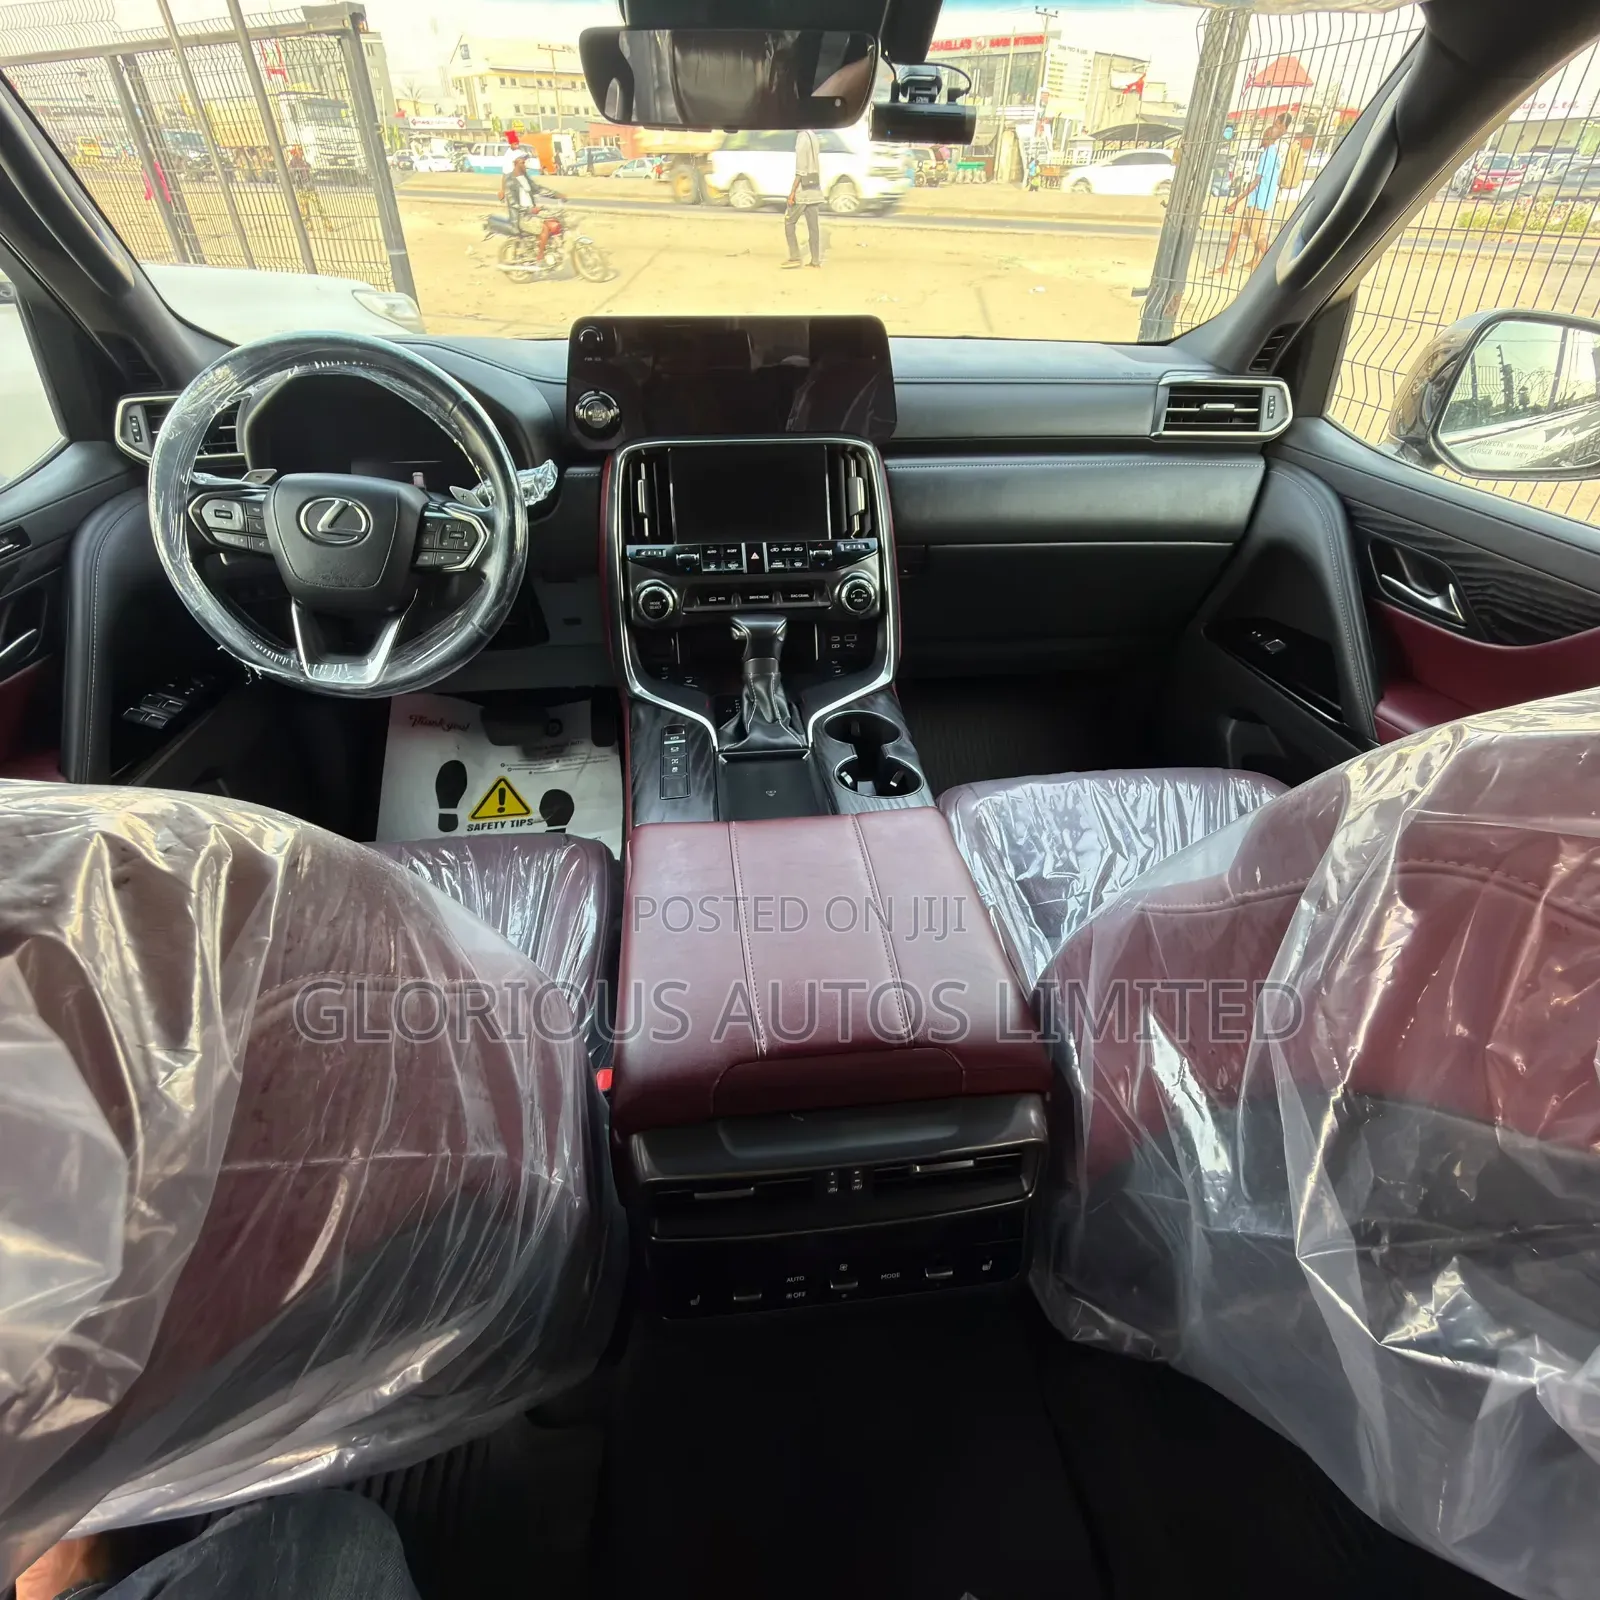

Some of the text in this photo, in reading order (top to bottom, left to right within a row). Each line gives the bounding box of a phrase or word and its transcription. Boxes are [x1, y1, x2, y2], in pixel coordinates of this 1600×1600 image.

[467, 818, 534, 832] SAFETY TIPS
[786, 1275, 805, 1283] AUTO
[880, 1272, 901, 1280] MODE
[792, 1291, 807, 1299] OFF
